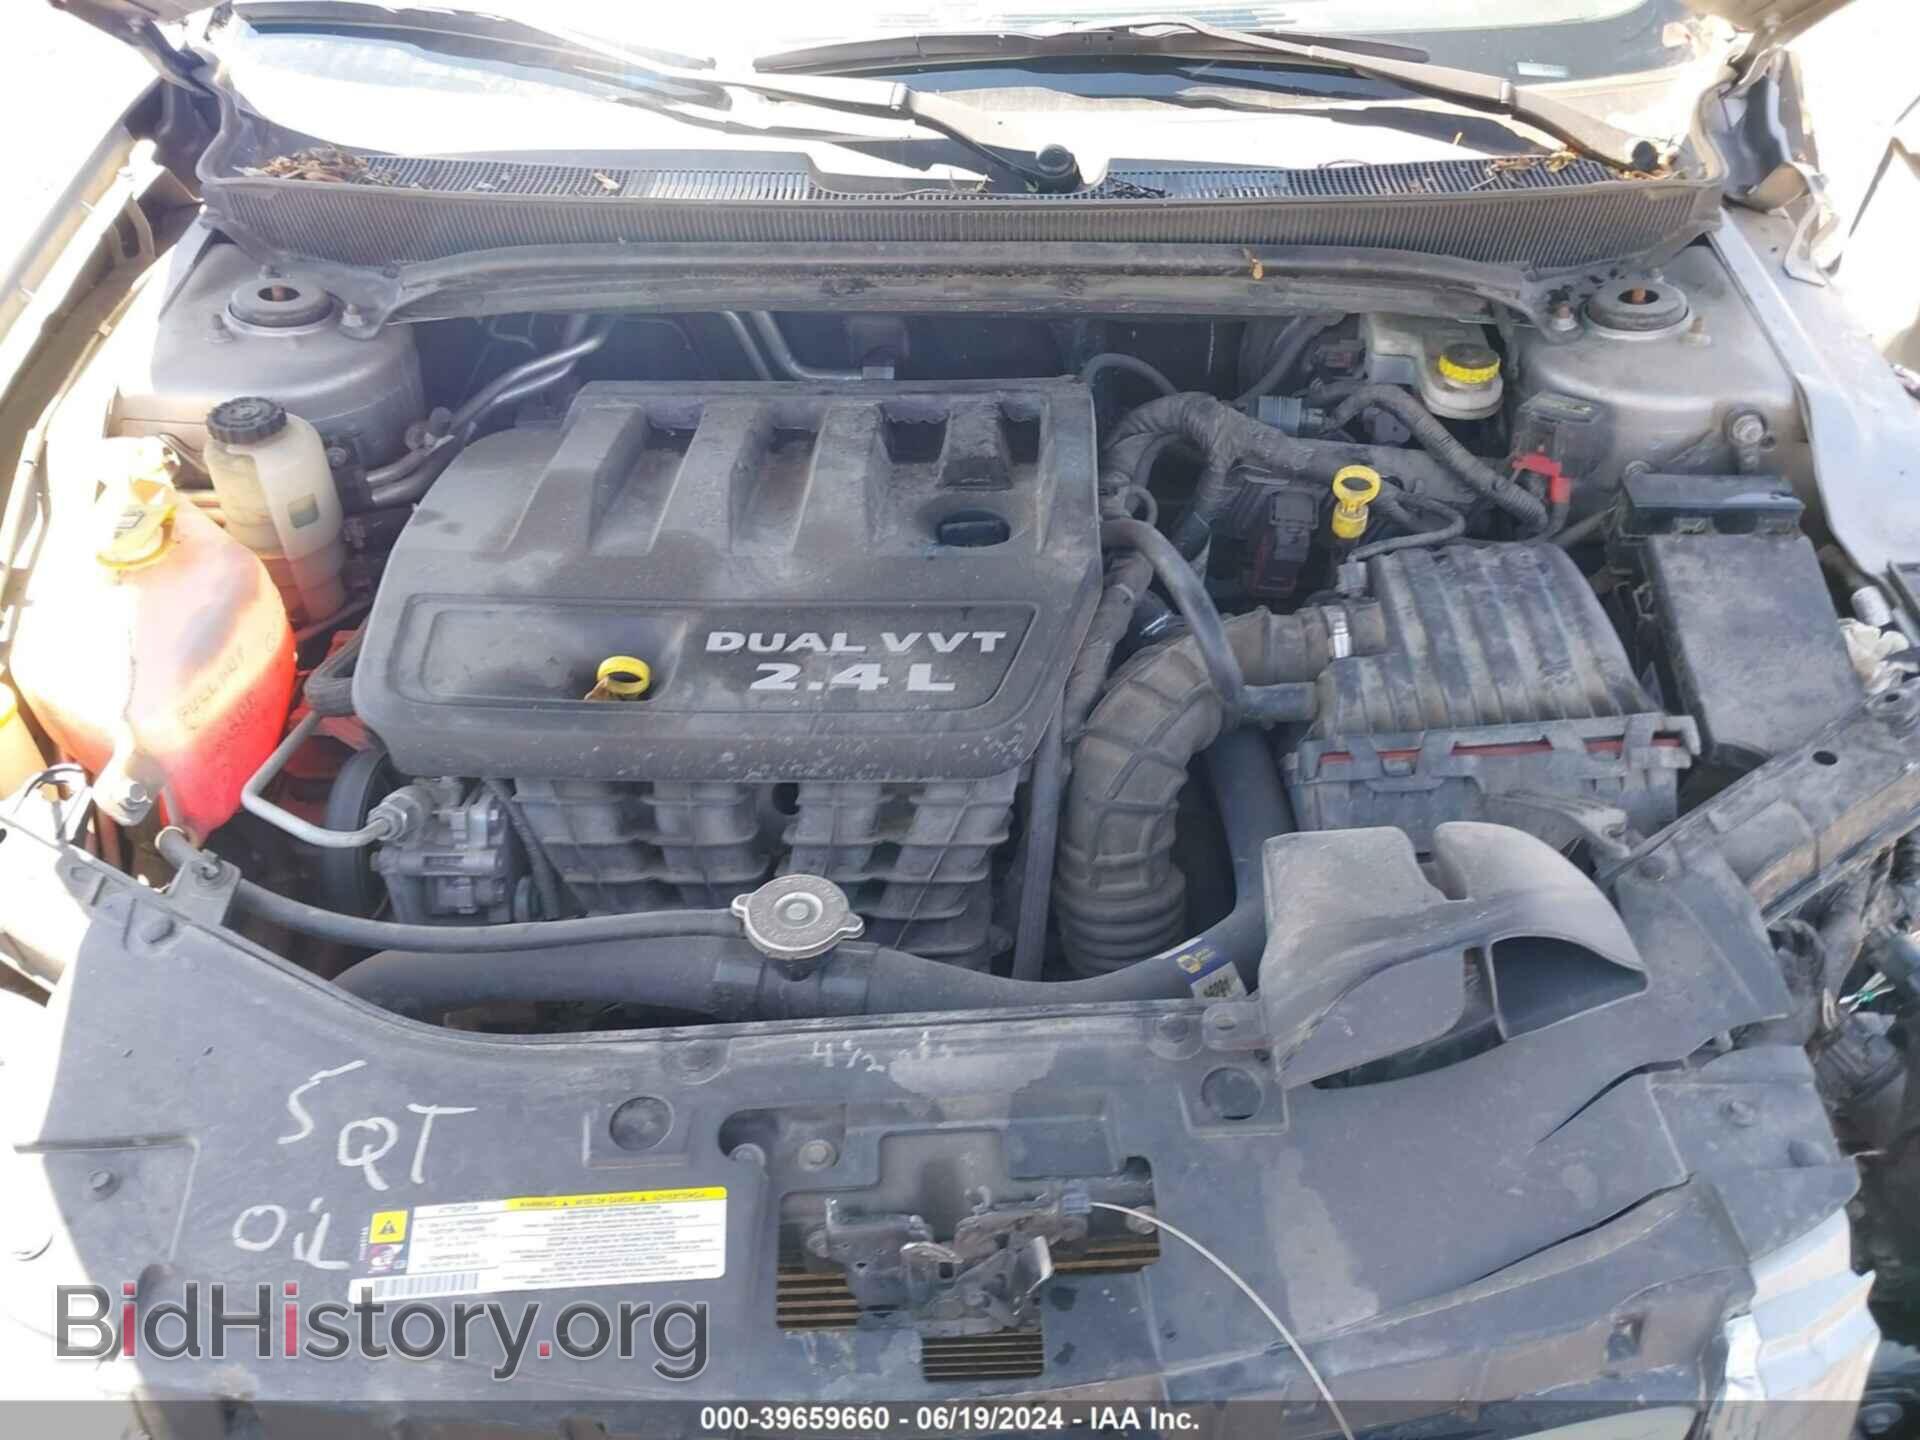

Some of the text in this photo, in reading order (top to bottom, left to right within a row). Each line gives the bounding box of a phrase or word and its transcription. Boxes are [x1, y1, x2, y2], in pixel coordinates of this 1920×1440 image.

[706, 631, 1007, 653] DUAL VVT
[337, 1103, 478, 1191] QT
